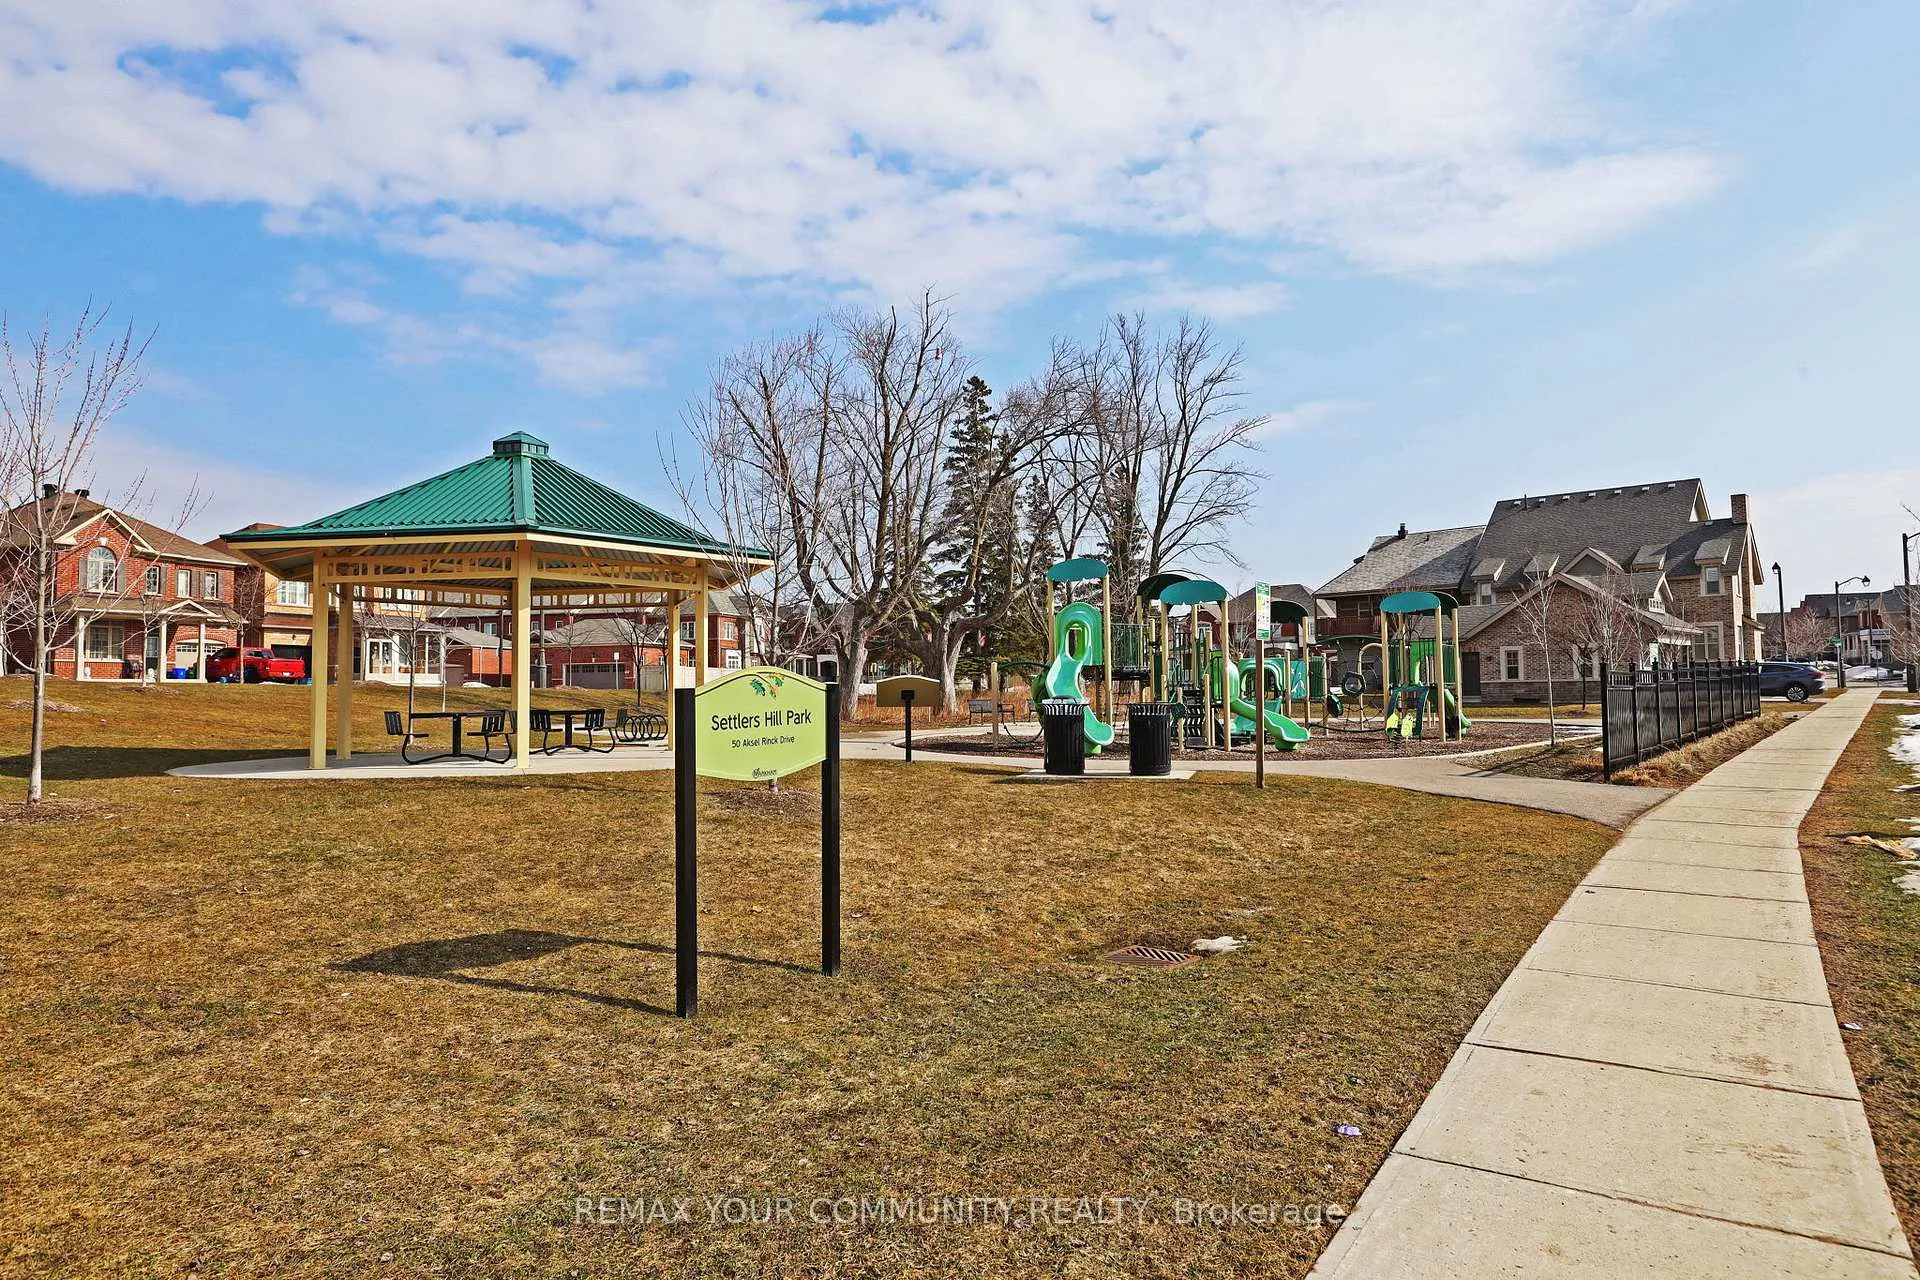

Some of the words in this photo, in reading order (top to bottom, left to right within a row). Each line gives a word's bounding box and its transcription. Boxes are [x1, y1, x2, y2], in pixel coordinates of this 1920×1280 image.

[711, 713, 761, 731] Settlers
[765, 710, 783, 728] Hill
[786, 708, 812, 725] Park
[731, 739, 741, 749] 50
[742, 737, 761, 748] Aksel
[761, 735, 779, 746] Rinck
[780, 735, 795, 744] Drive
